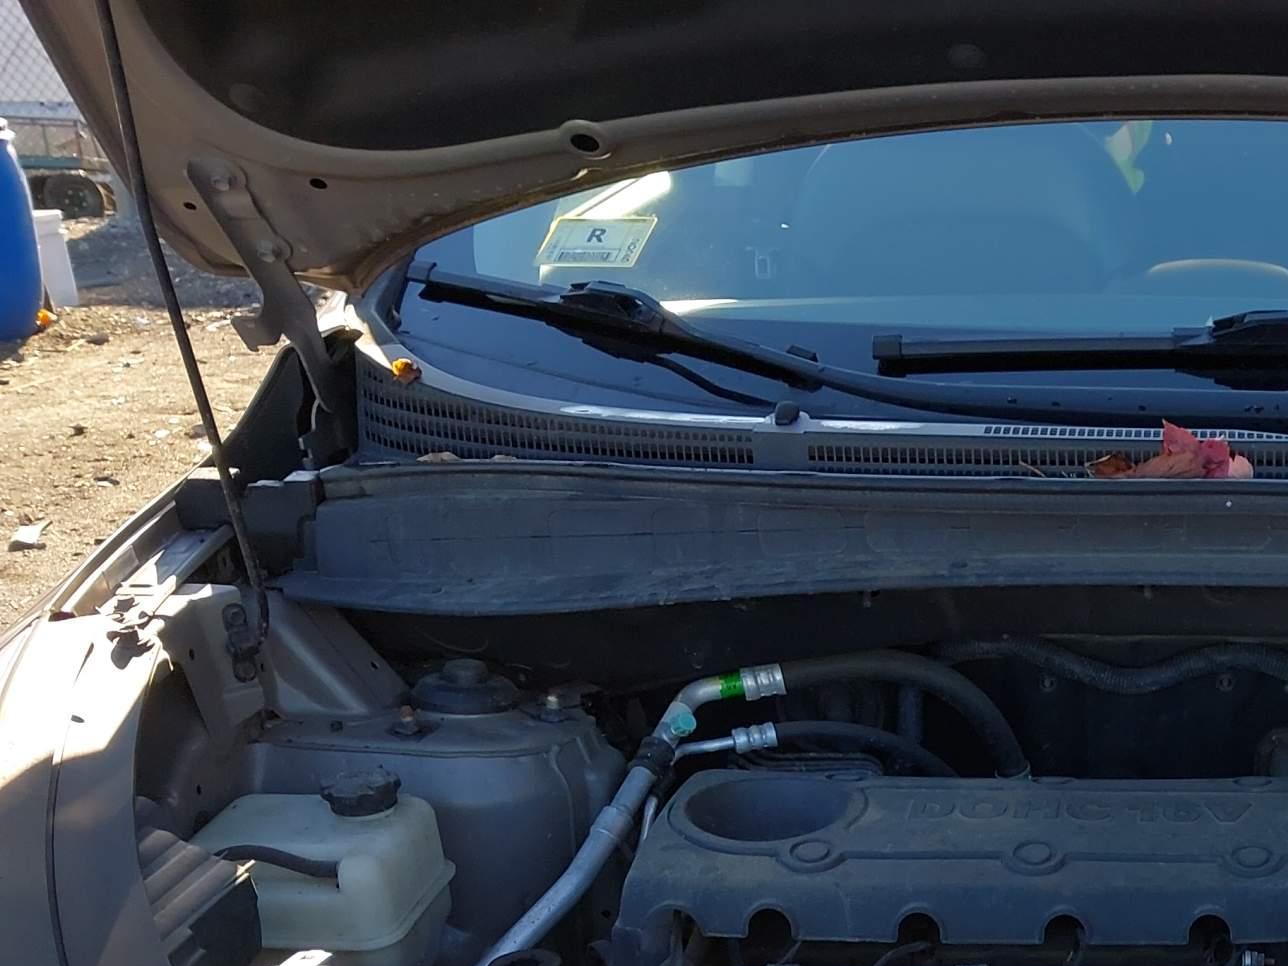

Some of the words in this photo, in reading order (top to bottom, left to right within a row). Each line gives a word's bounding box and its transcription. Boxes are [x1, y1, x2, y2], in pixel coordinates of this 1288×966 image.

[586, 227, 607, 243] R
[908, 799, 1113, 823] DOHC
[1128, 799, 1253, 825] 16V
